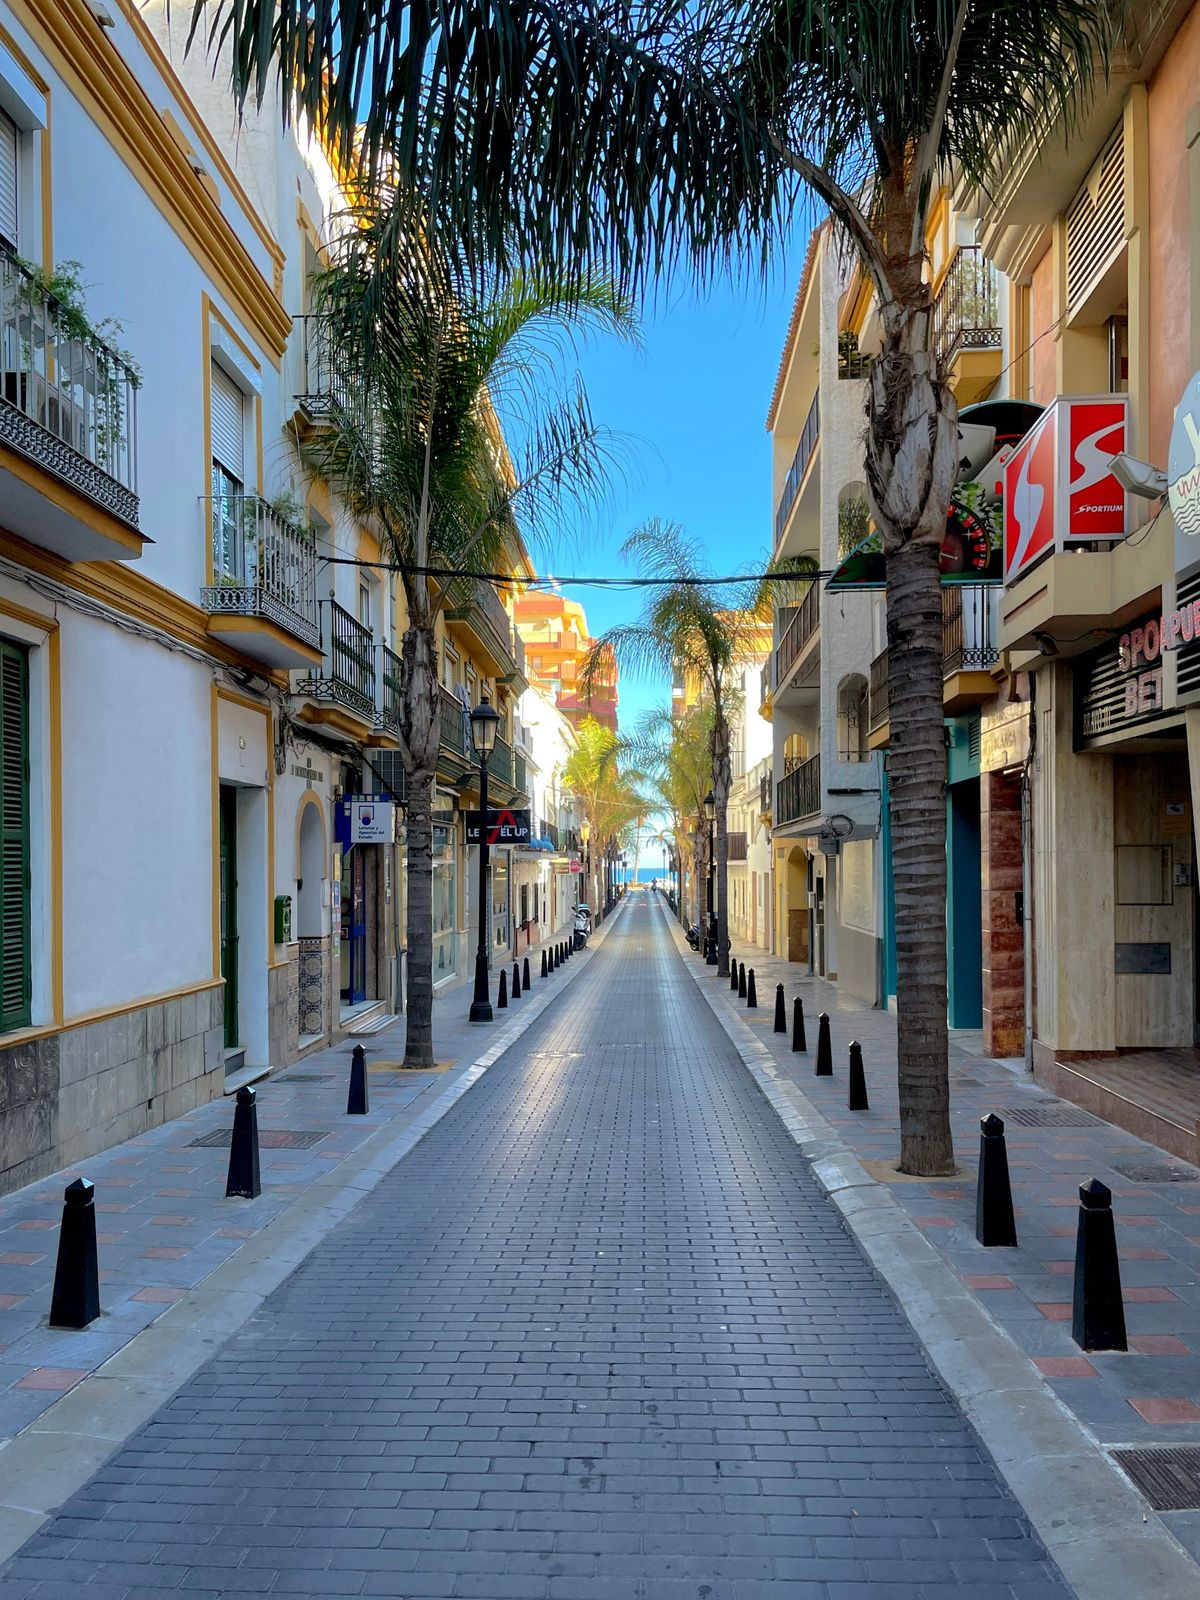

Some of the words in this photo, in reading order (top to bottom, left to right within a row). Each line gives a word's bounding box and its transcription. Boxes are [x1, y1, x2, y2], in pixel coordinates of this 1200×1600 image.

[1073, 504, 1123, 514] SPORTIUM
[1125, 667, 1163, 718] BET
[514, 828, 528, 837] UP
